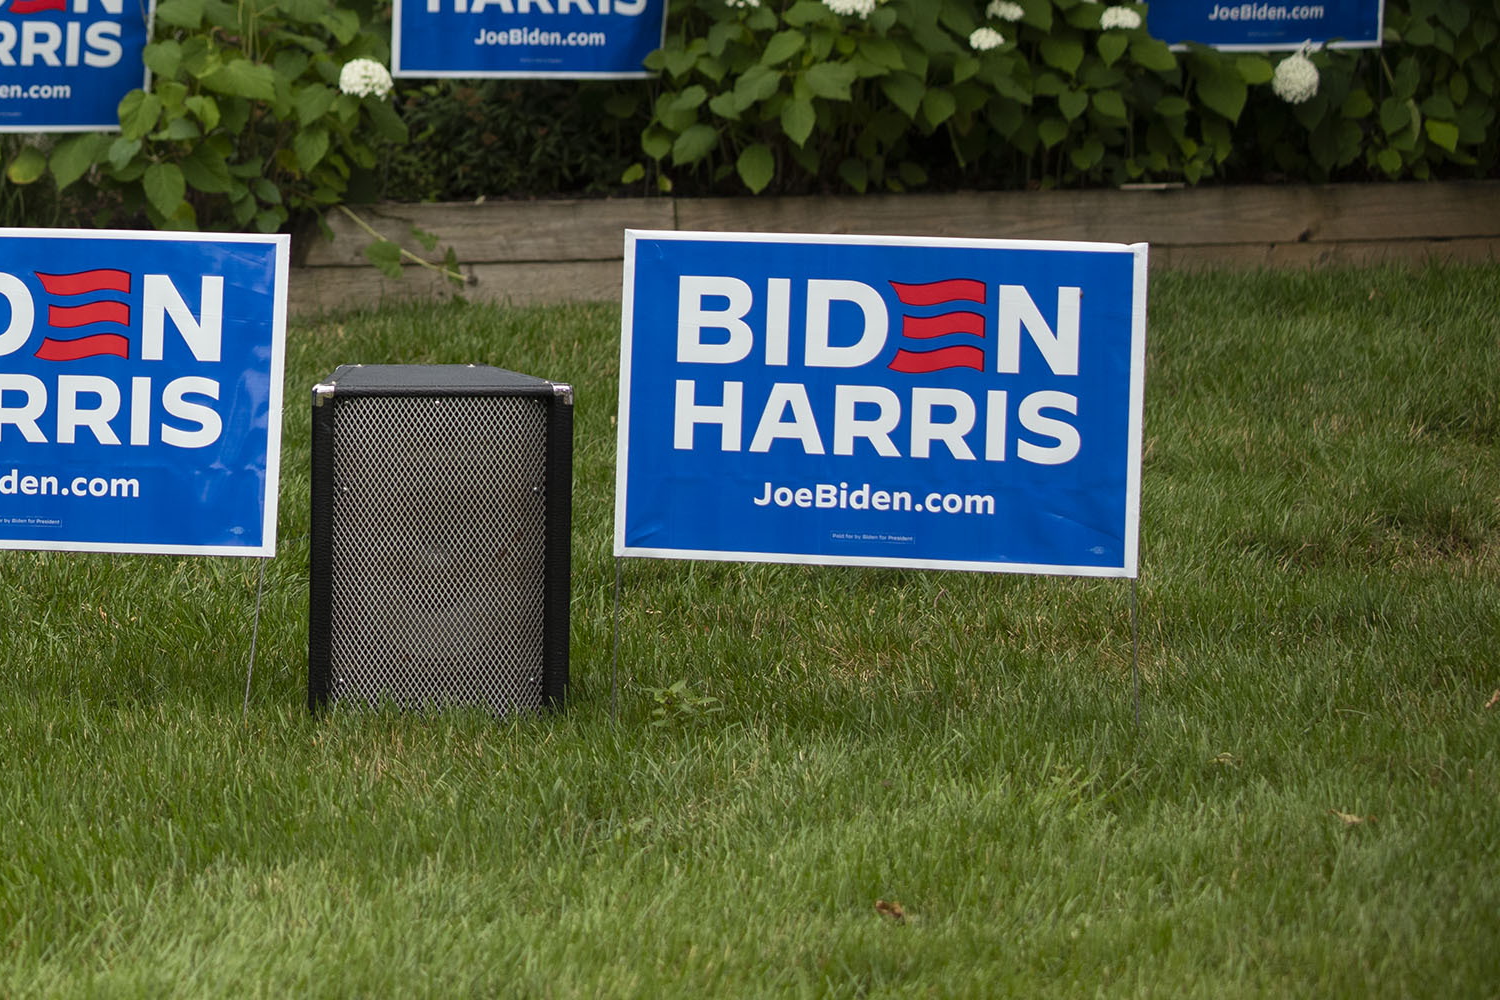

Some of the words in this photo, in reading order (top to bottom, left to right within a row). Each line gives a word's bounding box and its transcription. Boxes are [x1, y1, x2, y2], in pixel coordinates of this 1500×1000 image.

[1208, 2, 1325, 21] JoeBiden.com
[475, 27, 606, 47] JoeBiden.com
[676, 275, 1082, 376] BIDEN
[672, 379, 1082, 466] HARRIS
[753, 481, 996, 516] JoeBiden.com
